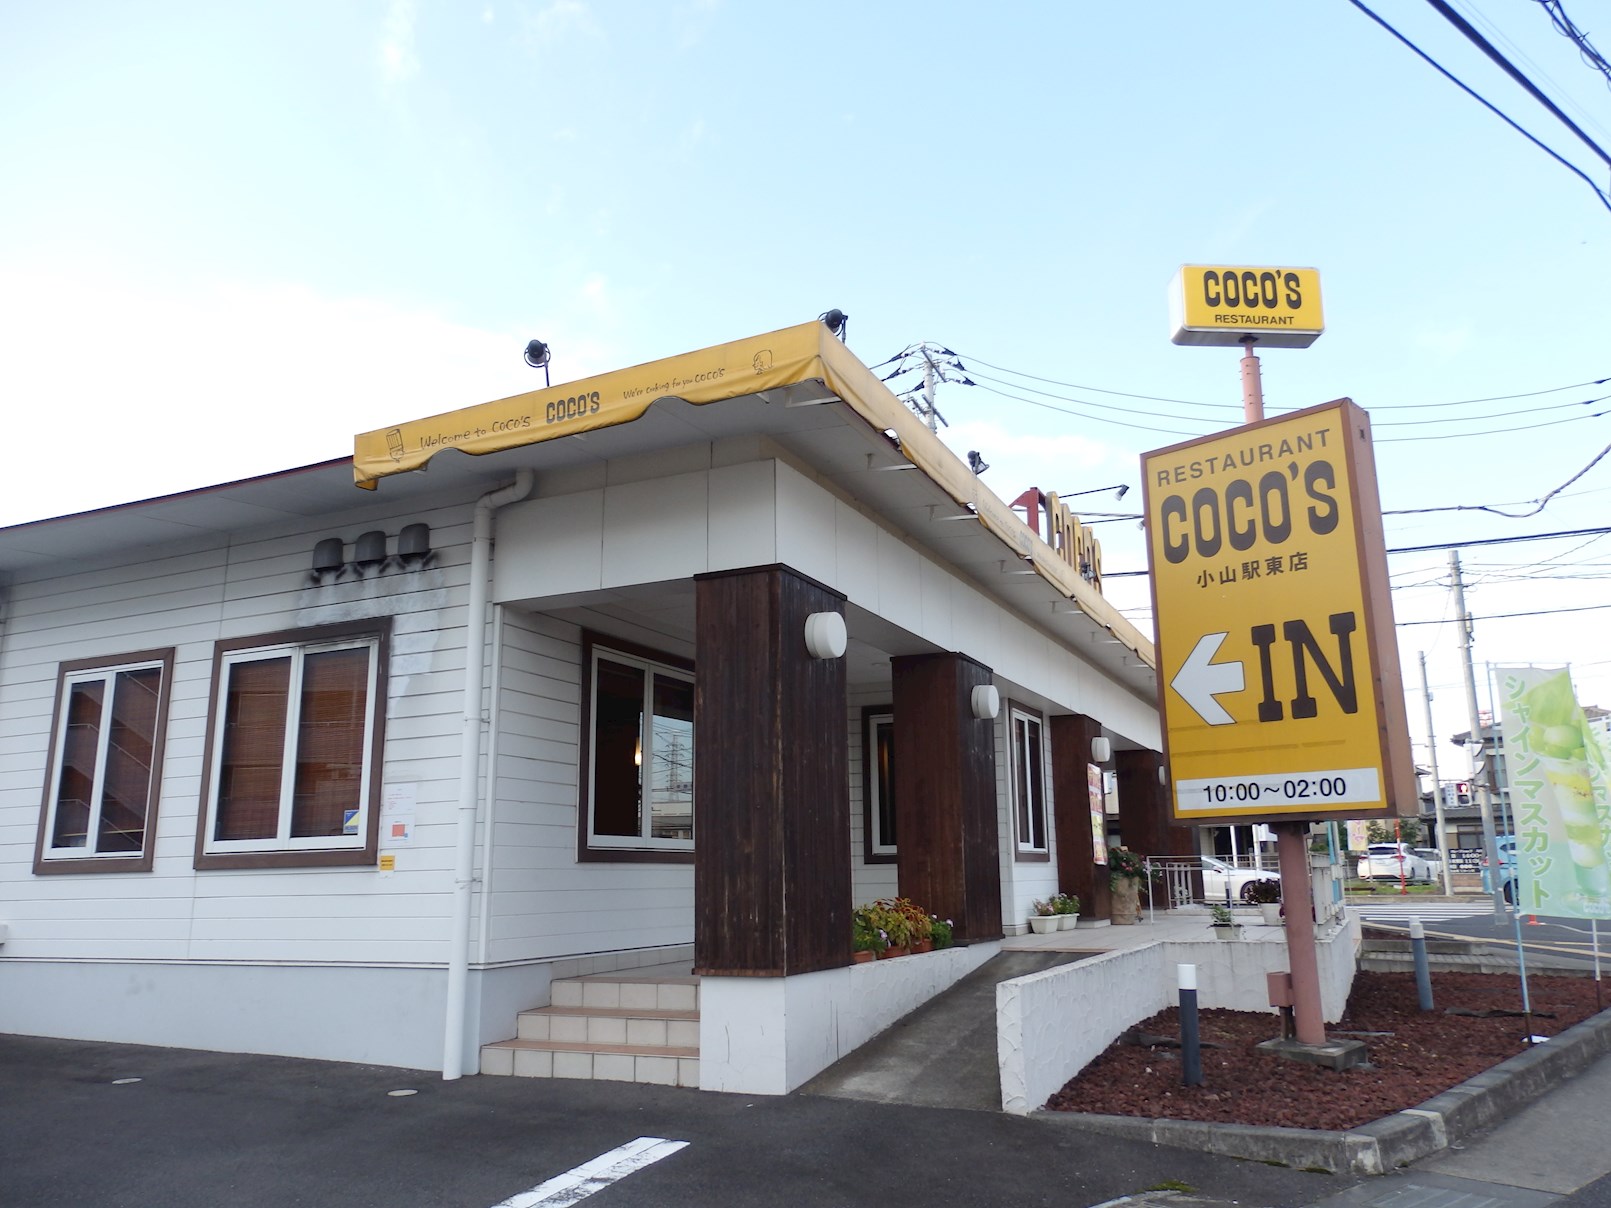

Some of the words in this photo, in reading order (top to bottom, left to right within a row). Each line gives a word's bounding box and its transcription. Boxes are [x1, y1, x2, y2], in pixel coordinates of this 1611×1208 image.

[1203, 270, 1302, 310] COCO'S
[1215, 314, 1294, 325] RESTAURANT
[546, 391, 600, 424] COCO'S
[420, 430, 470, 450] Welcome
[474, 428, 487, 438] to
[1157, 428, 1331, 488] RESTAURANT
[1160, 460, 1339, 565] COCO'S
[1197, 551, 1309, 589] 小山駅東店
[1250, 611, 1359, 723] IN
[1505, 674, 1552, 909] シャインマスカット
